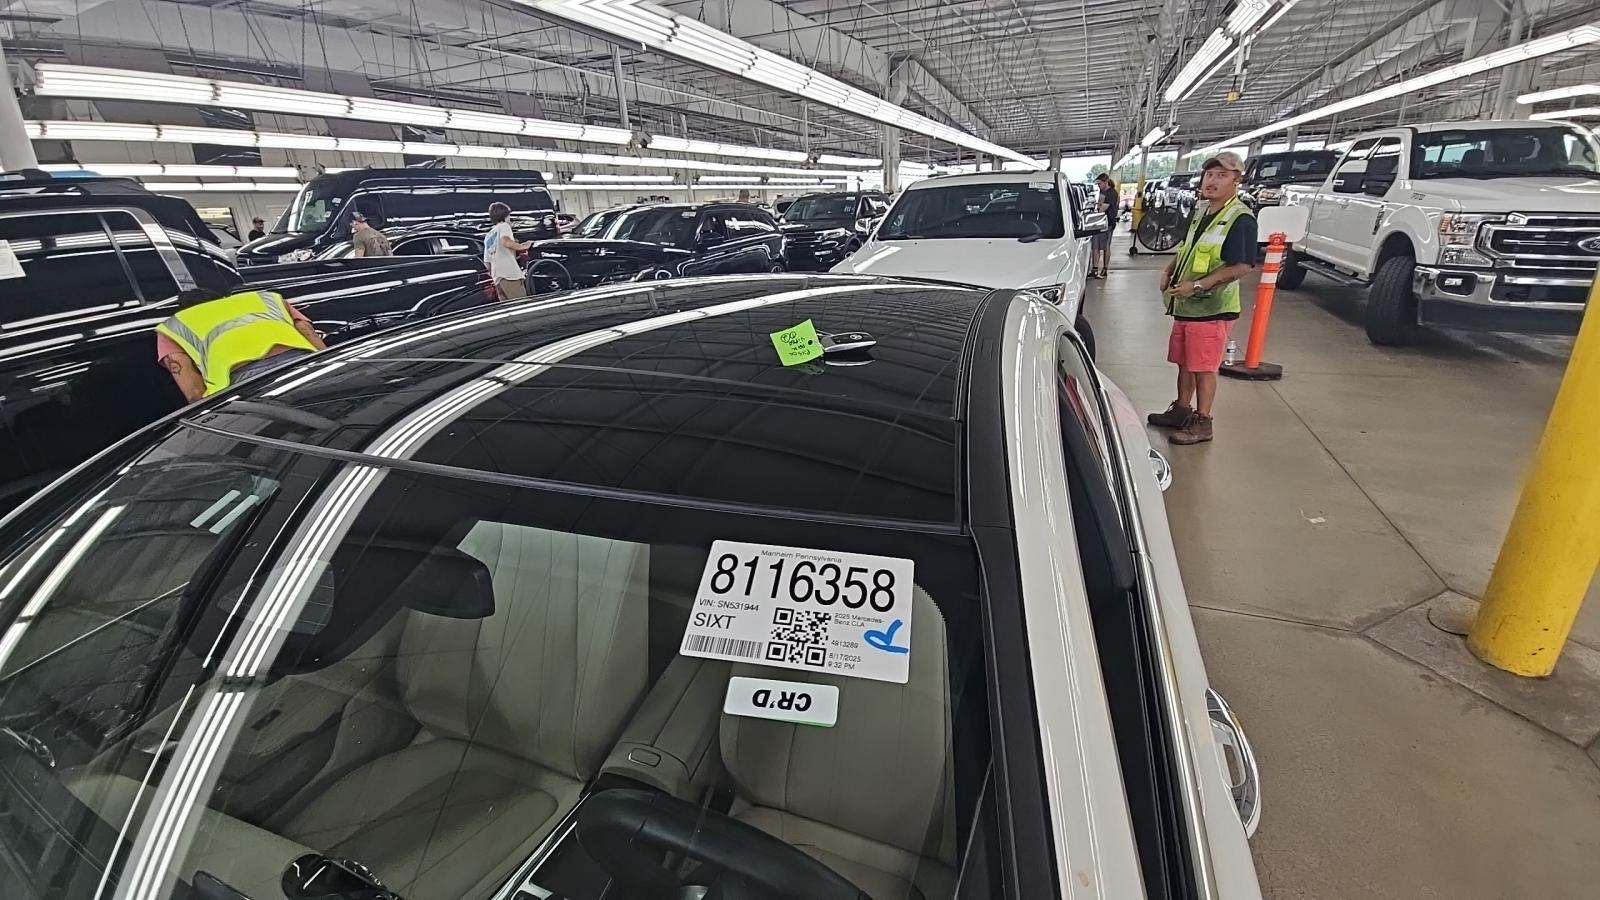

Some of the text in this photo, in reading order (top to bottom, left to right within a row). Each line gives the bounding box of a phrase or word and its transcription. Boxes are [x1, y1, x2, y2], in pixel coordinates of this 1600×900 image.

[761, 549, 842, 564] Manheim Pennsylvania
[710, 553, 896, 612] 8116358
[698, 598, 759, 611] VIN: SN531944
[694, 613, 736, 629] SIXT
